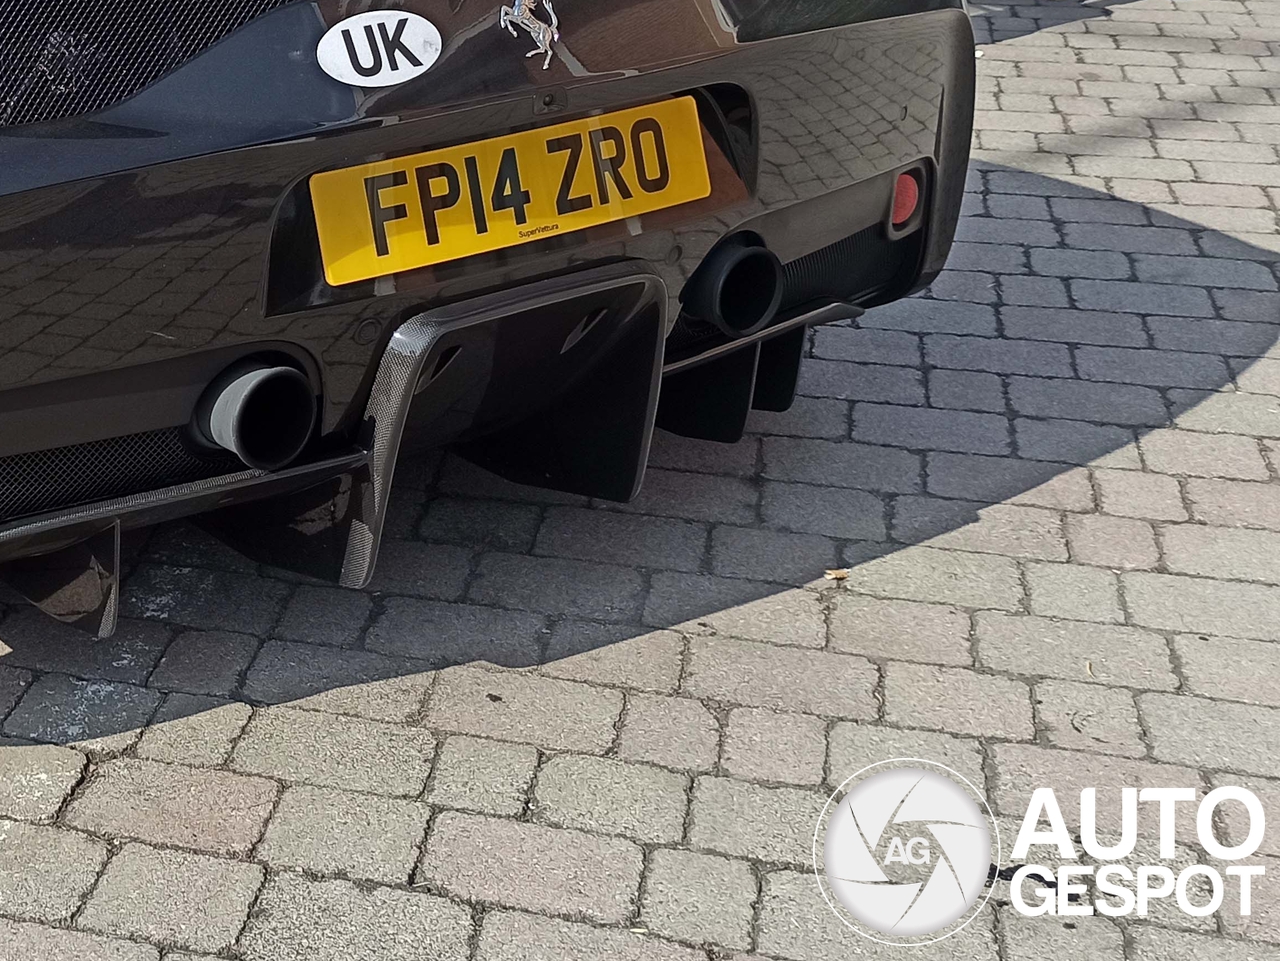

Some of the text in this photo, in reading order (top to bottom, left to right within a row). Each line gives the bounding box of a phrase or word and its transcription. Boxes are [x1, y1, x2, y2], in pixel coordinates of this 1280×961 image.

[341, 17, 424, 77] UK
[363, 117, 671, 258] FP14 ZRO
[518, 223, 560, 239] SuperVettura
